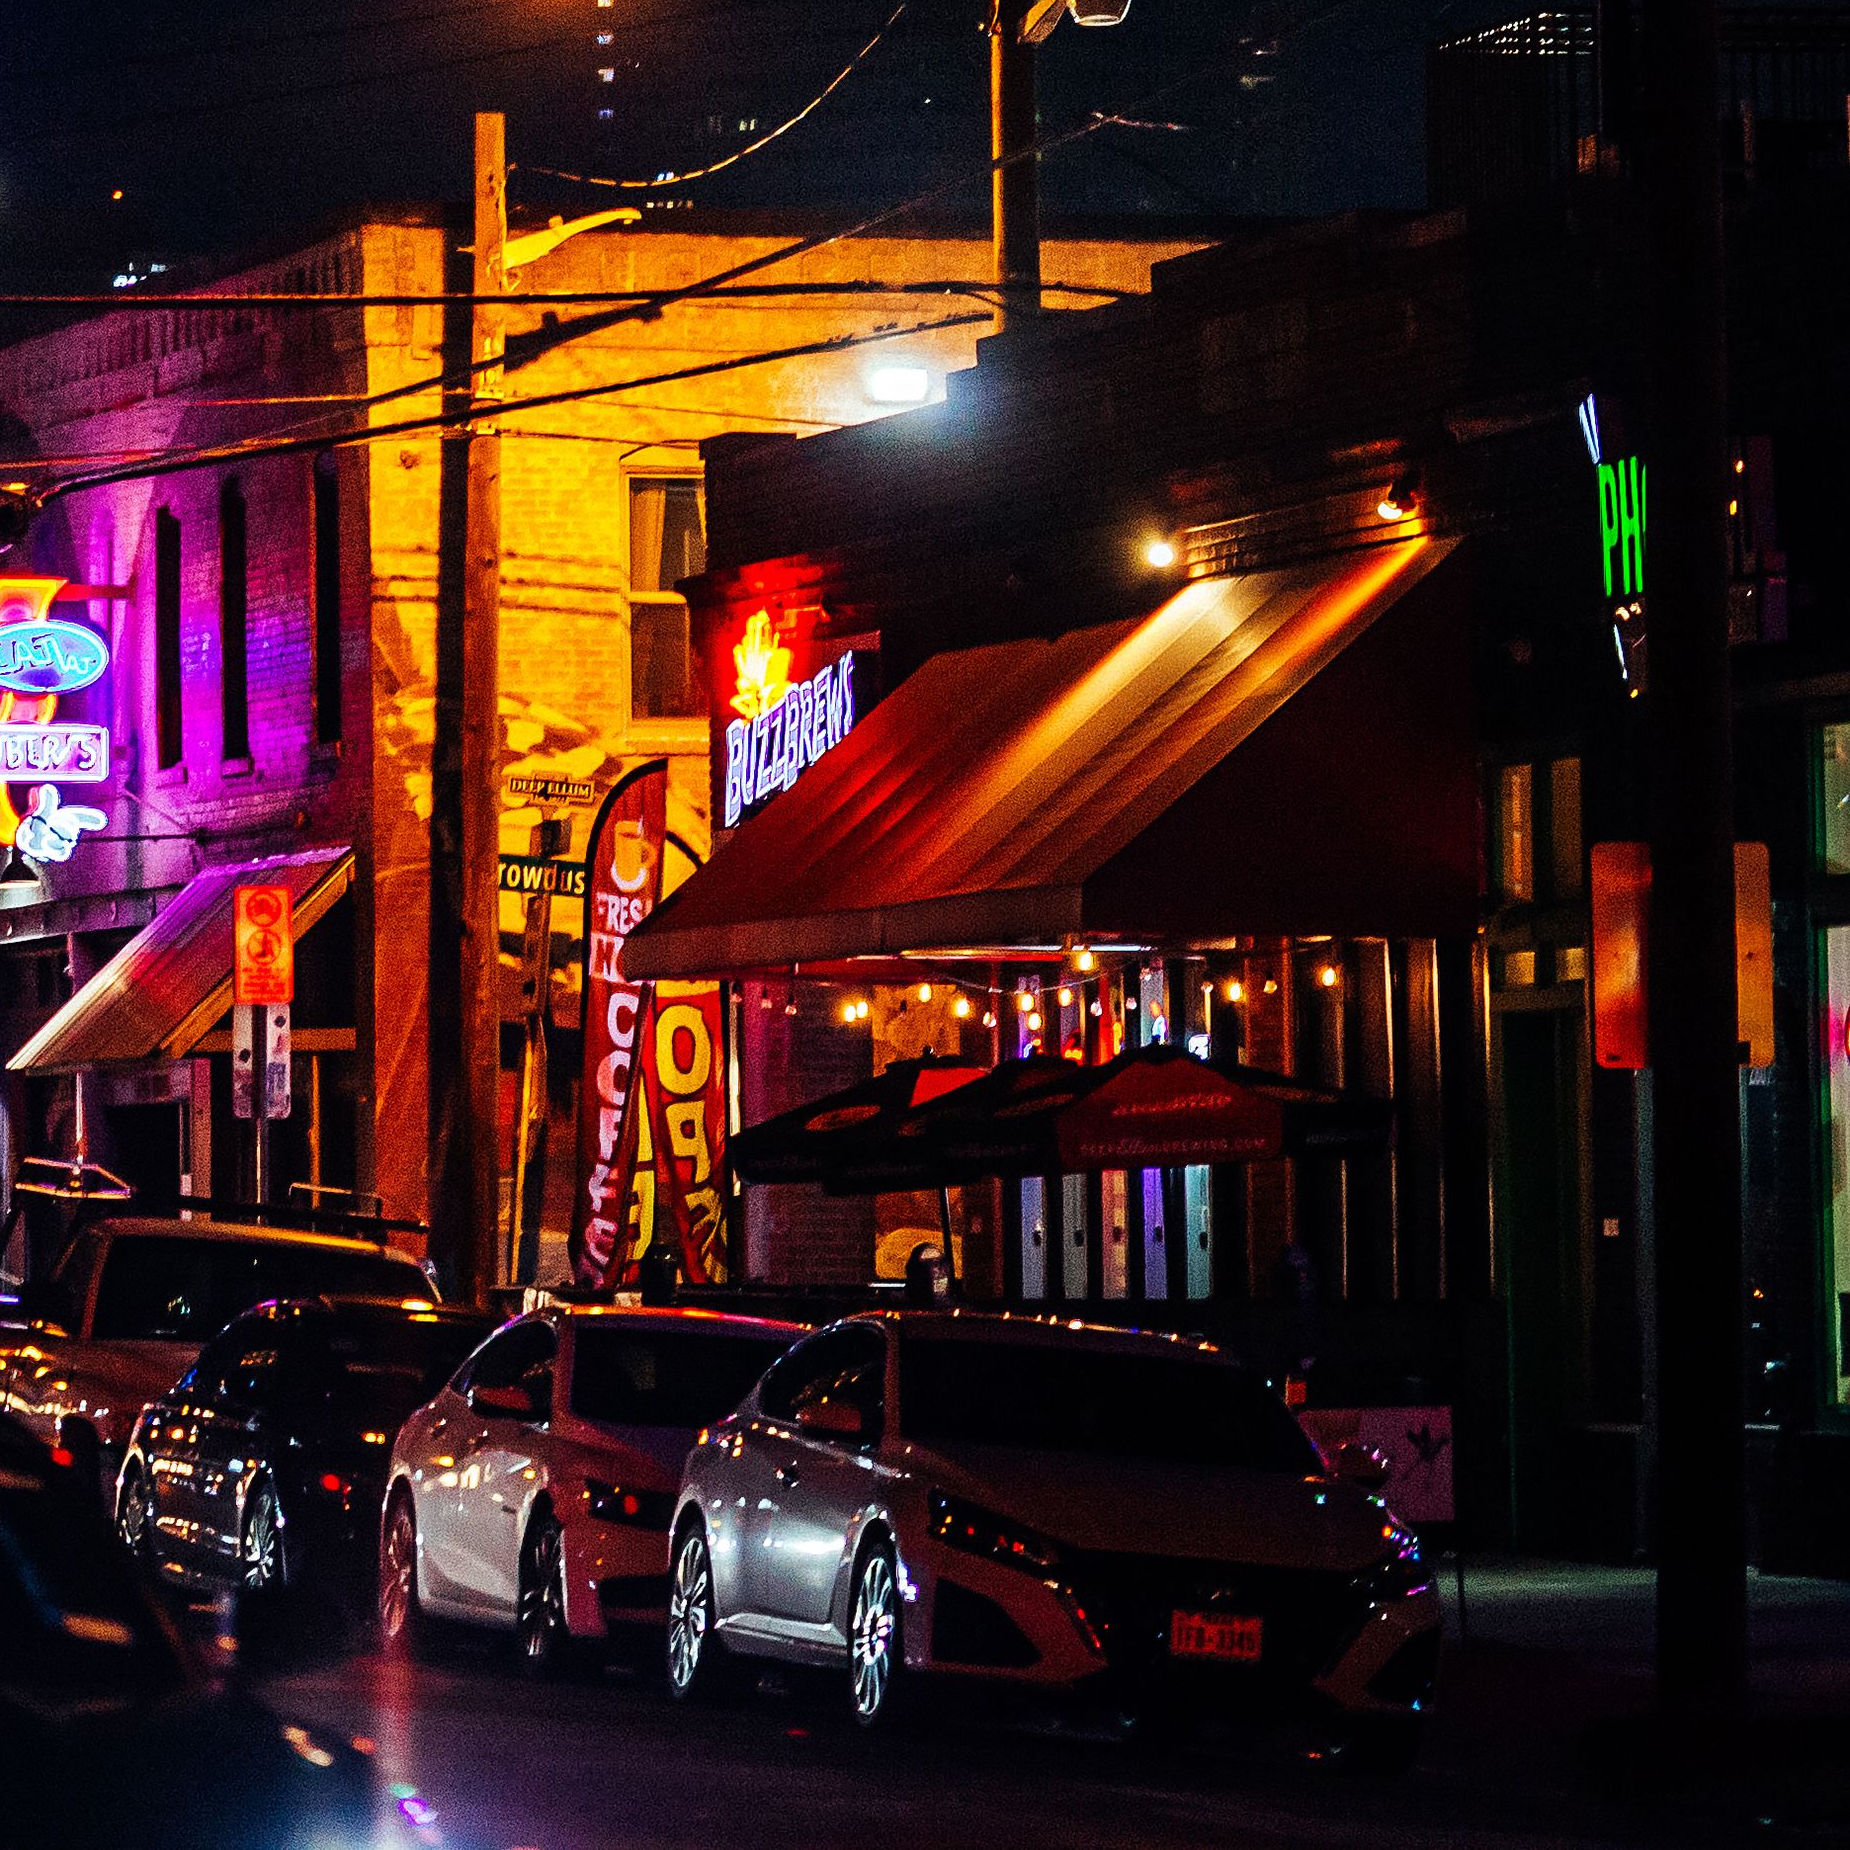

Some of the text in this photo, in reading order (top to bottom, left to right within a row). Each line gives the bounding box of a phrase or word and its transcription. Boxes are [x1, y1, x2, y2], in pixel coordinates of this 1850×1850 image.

[1596, 455, 1647, 598] PH
[724, 649, 855, 828] BUZZBREWS
[512, 778, 590, 799] DEEP ELLUM
[498, 862, 586, 895] rowdus
